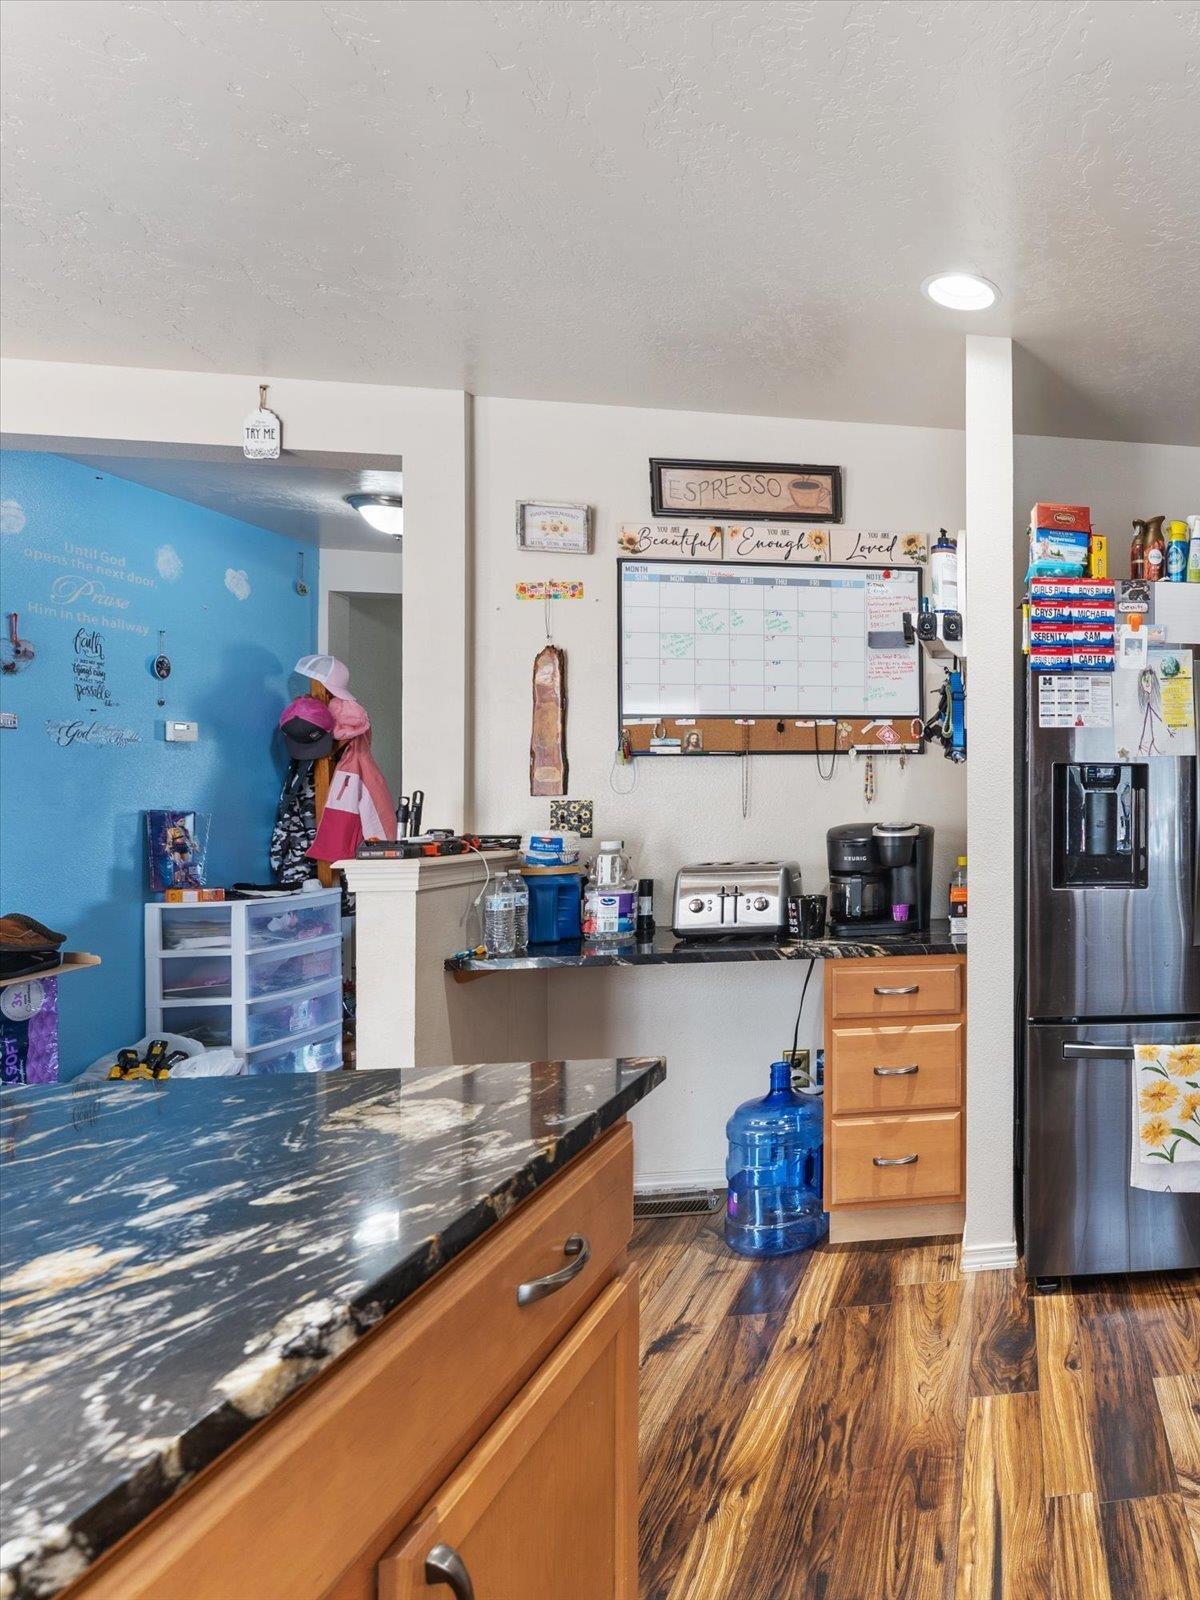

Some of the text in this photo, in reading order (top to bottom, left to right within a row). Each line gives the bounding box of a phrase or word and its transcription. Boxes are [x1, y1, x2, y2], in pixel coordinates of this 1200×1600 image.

[246, 428, 275, 440] TRY ME
[668, 474, 782, 505] ESPRESSO
[767, 528, 778, 536] YOU
[638, 527, 719, 556] Beautiful
[737, 527, 811, 560] Enough
[846, 533, 897, 561] Loved
[64, 541, 126, 567] Until God
[71, 558, 94, 572] the
[96, 564, 125, 581] next
[706, 576, 719, 584] TUE
[740, 577, 754, 585] WED
[775, 578, 788, 586] THU
[1034, 585, 1053, 594] GIRLS
[1079, 587, 1095, 595] BOYS
[1035, 607, 1064, 616] CRYSTAL
[1077, 610, 1108, 618] MICHAEL
[28, 601, 57, 617] Him
[76, 611, 97, 625] the
[102, 616, 150, 636] hallway
[1034, 632, 1068, 641] SERENITY
[1084, 632, 1101, 640] SAM
[1079, 655, 1106, 664] CARTER
[57, 720, 97, 747] God
[5, 1038, 18, 1076] SOFT
